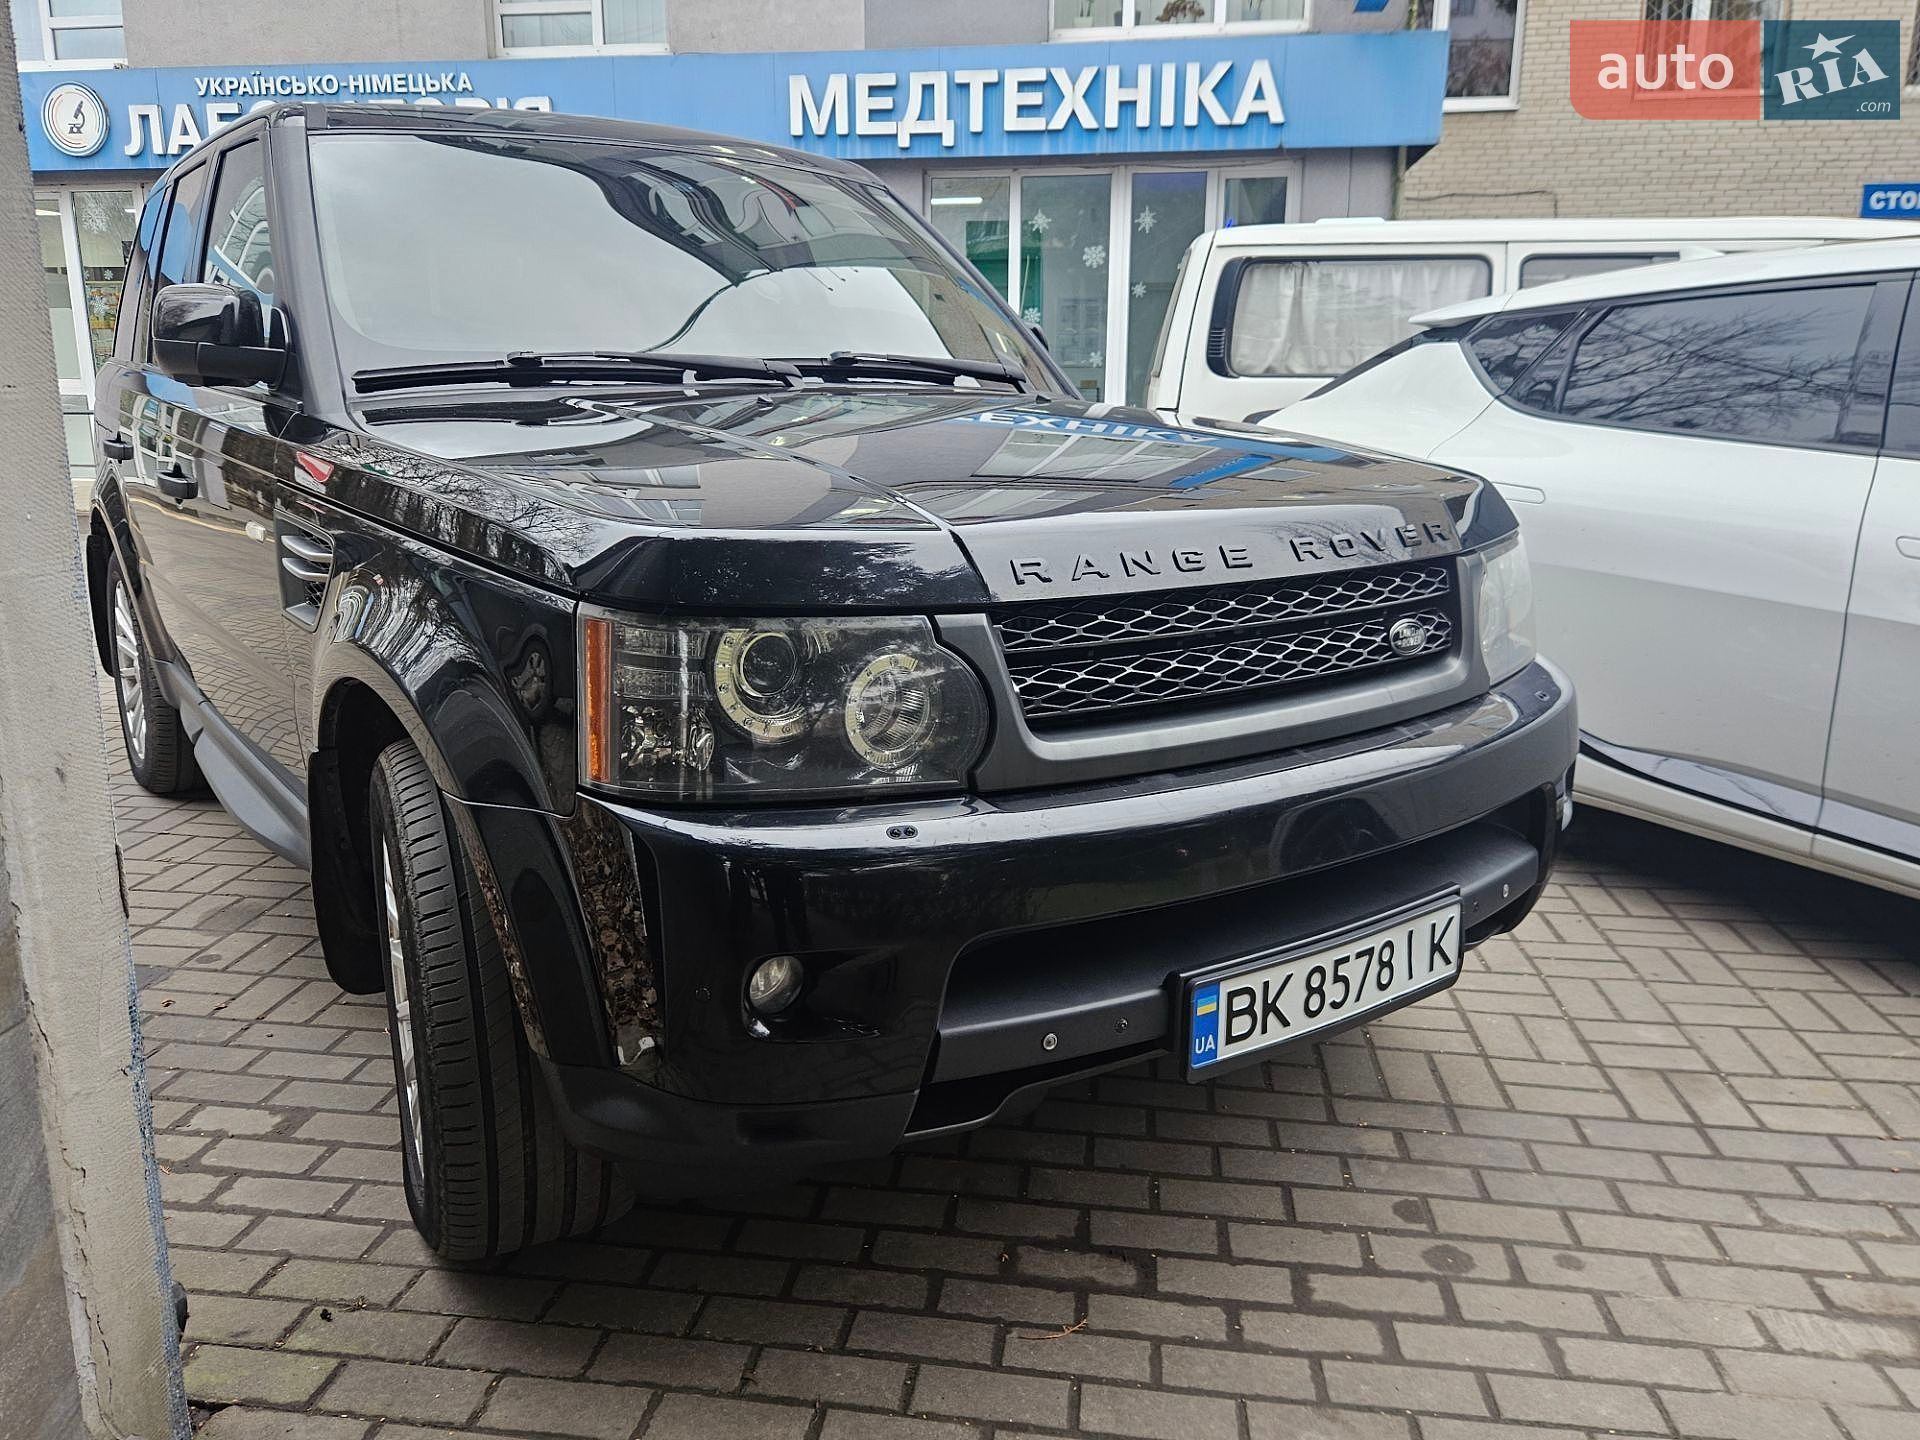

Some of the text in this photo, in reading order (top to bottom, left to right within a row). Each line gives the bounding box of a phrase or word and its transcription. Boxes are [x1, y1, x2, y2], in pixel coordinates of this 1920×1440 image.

[194, 71, 474, 97] УКРАЇНСЬКО-НІМЕЦЬКА
[788, 59, 1286, 149] МЕДТЕХНІКА
[1869, 190, 1920, 210] СТО
[1010, 522, 1450, 586] RANGE ROVER
[1225, 972, 1294, 1046] BK
[1303, 940, 1395, 1019] 8578
[1195, 1033, 1216, 1055] UA
